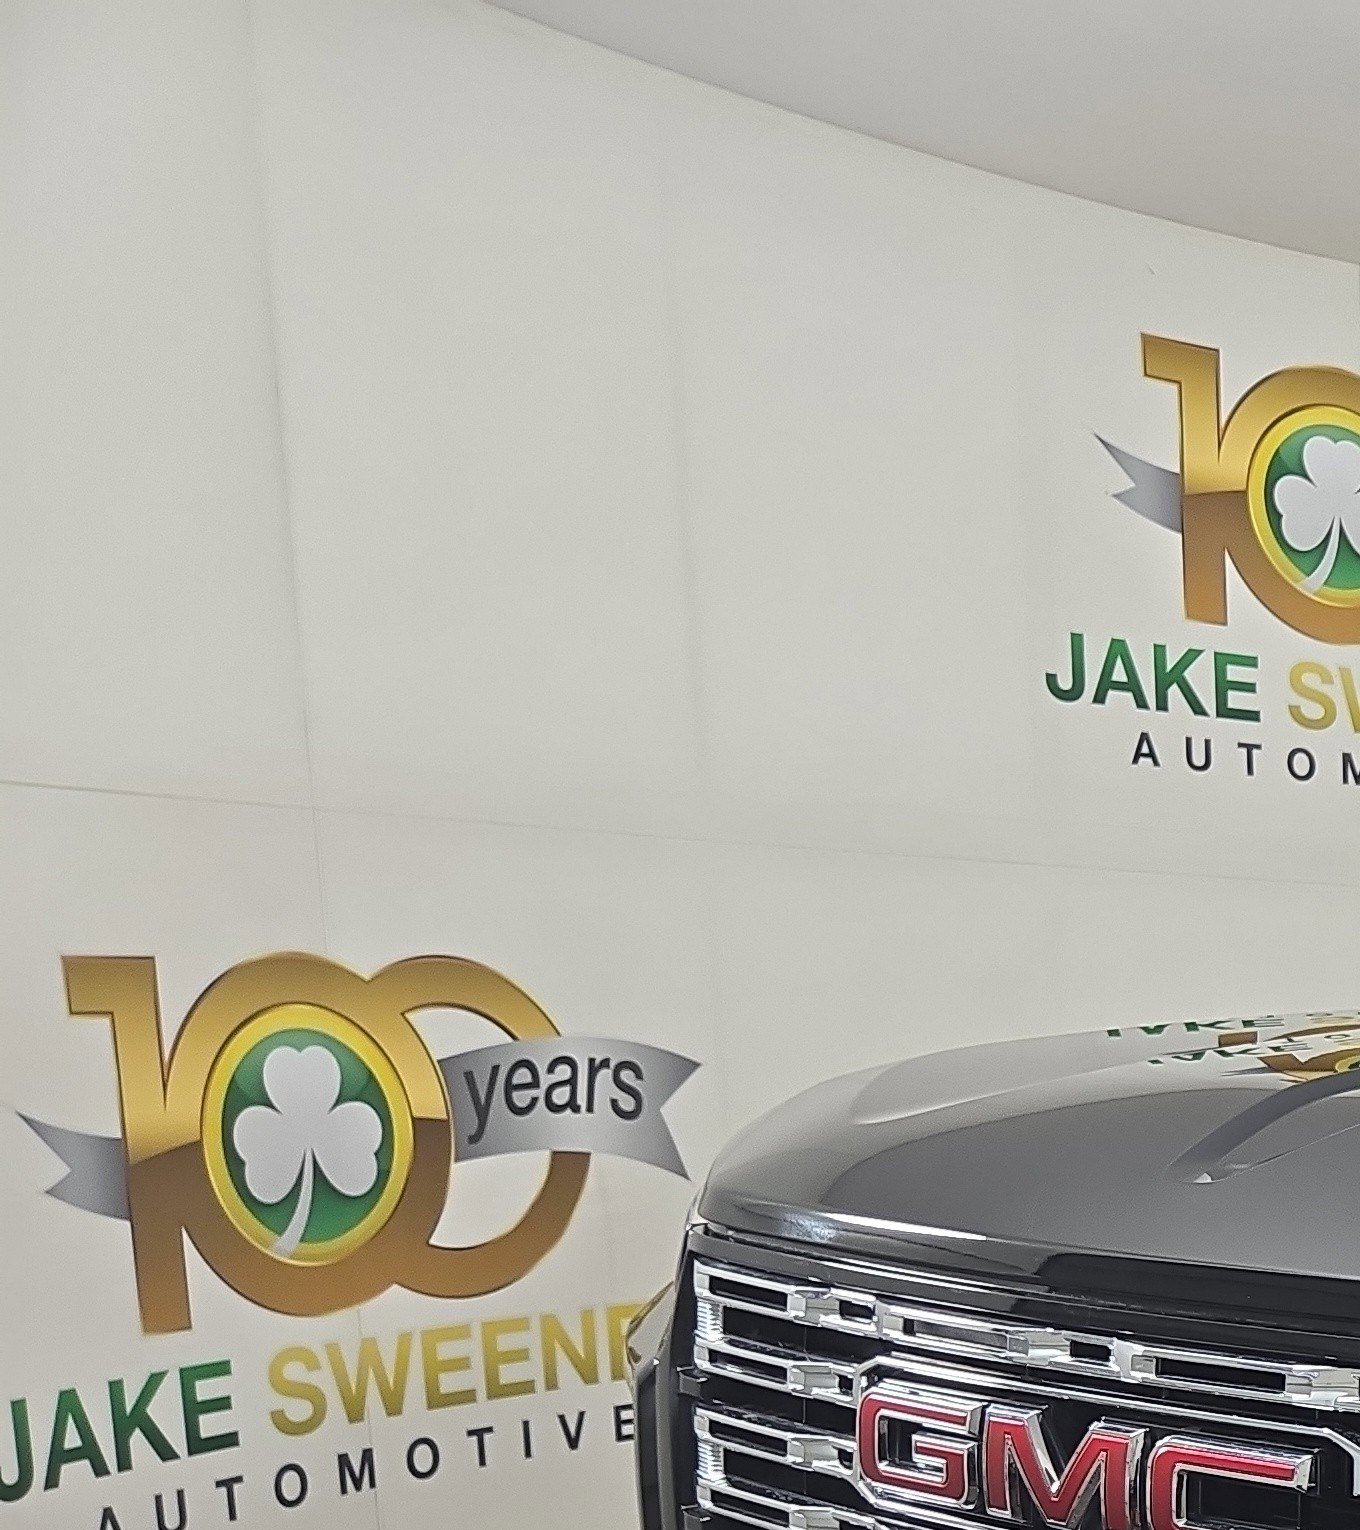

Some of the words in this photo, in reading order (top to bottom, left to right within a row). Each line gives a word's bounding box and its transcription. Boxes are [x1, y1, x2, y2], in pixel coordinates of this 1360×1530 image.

[1045, 631, 1262, 725] JAKE
[462, 1054, 646, 1146] years
[0, 1359, 241, 1503] JAKE
